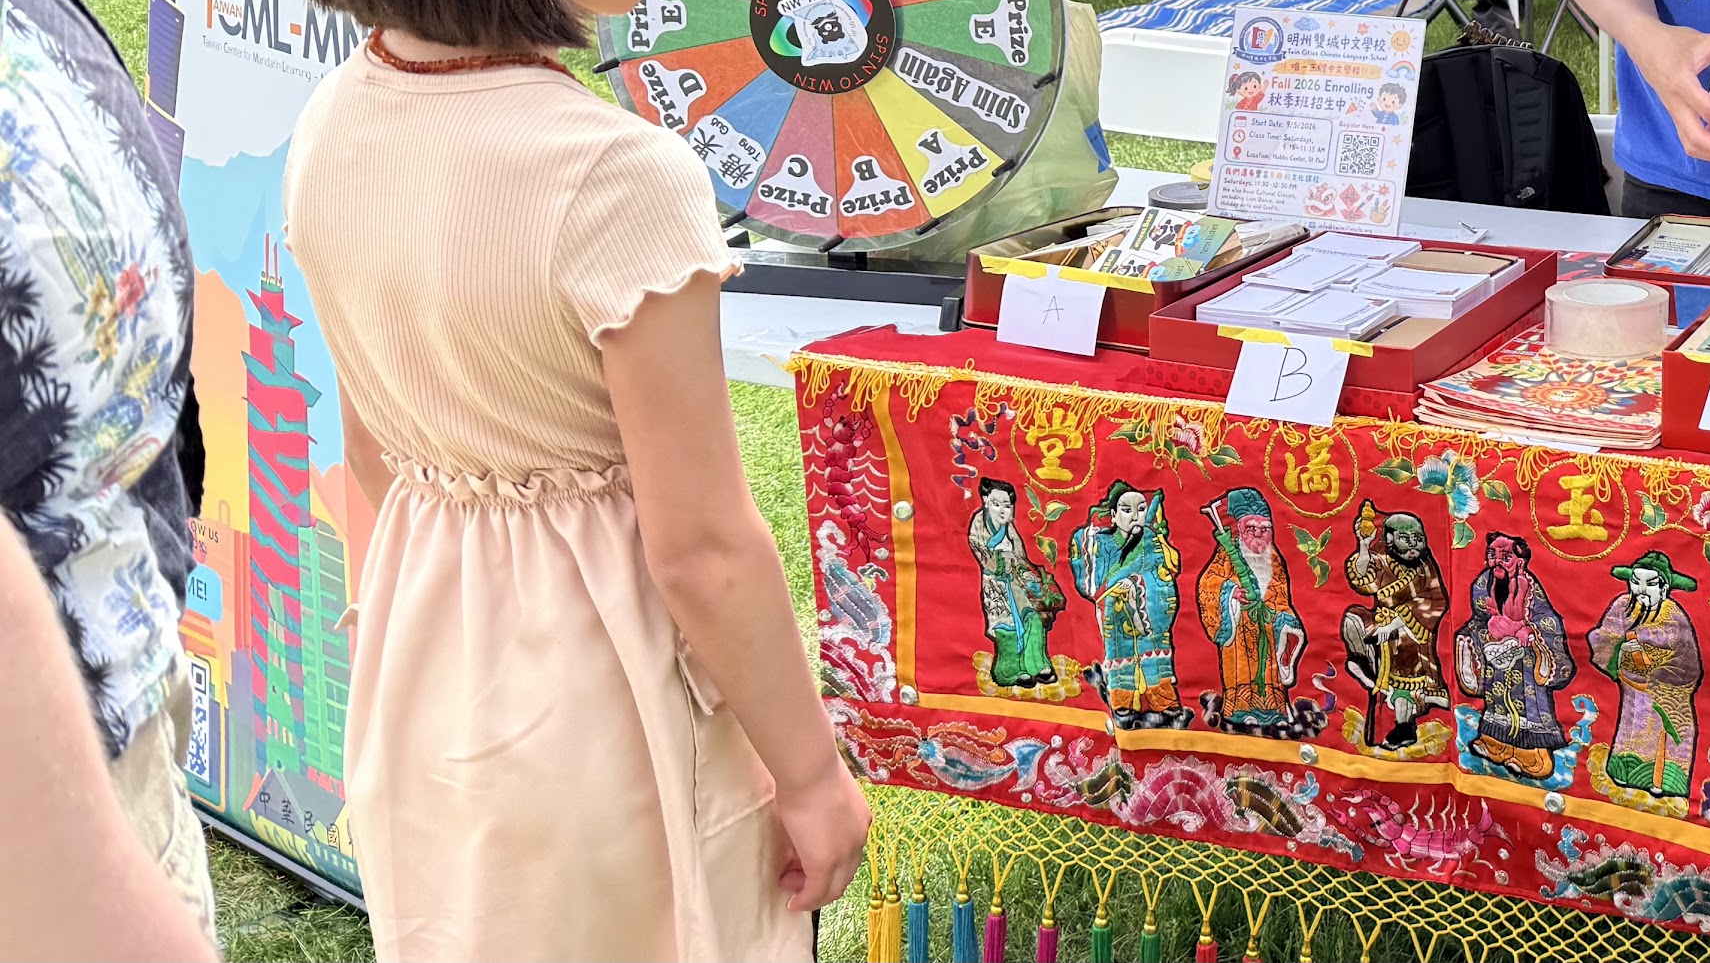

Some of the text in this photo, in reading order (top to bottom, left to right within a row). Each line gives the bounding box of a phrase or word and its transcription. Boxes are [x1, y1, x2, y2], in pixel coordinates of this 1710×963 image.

[661, 5, 682, 25] E
[972, 19, 996, 39] E
[1287, 33, 1386, 52] 明州雙城中文學校
[224, 42, 243, 56] Center
[253, 52, 281, 70] Mandarin
[282, 61, 311, 82] Learning
[794, 33, 889, 92] SPIN TO WIN
[642, 63, 685, 131] Prize
[678, 72, 703, 97] D
[899, 50, 1028, 130] Spin Again
[1271, 76, 1374, 99] Fall 2026 Enrolling
[1268, 92, 1346, 112] 秋季班招生中
[1249, 131, 1264, 139] Class
[1267, 132, 1282, 140] Time:
[1251, 118, 1316, 130] Start Date: 9/5/2026
[918, 130, 942, 155] A
[788, 157, 810, 177] C
[1246, 151, 1271, 160] Location:
[856, 159, 877, 180] B
[923, 146, 987, 195] Prize
[760, 182, 832, 216] Prize
[843, 185, 913, 214] Prize
[1042, 295, 1064, 324] A
[1269, 347, 1312, 402] B
